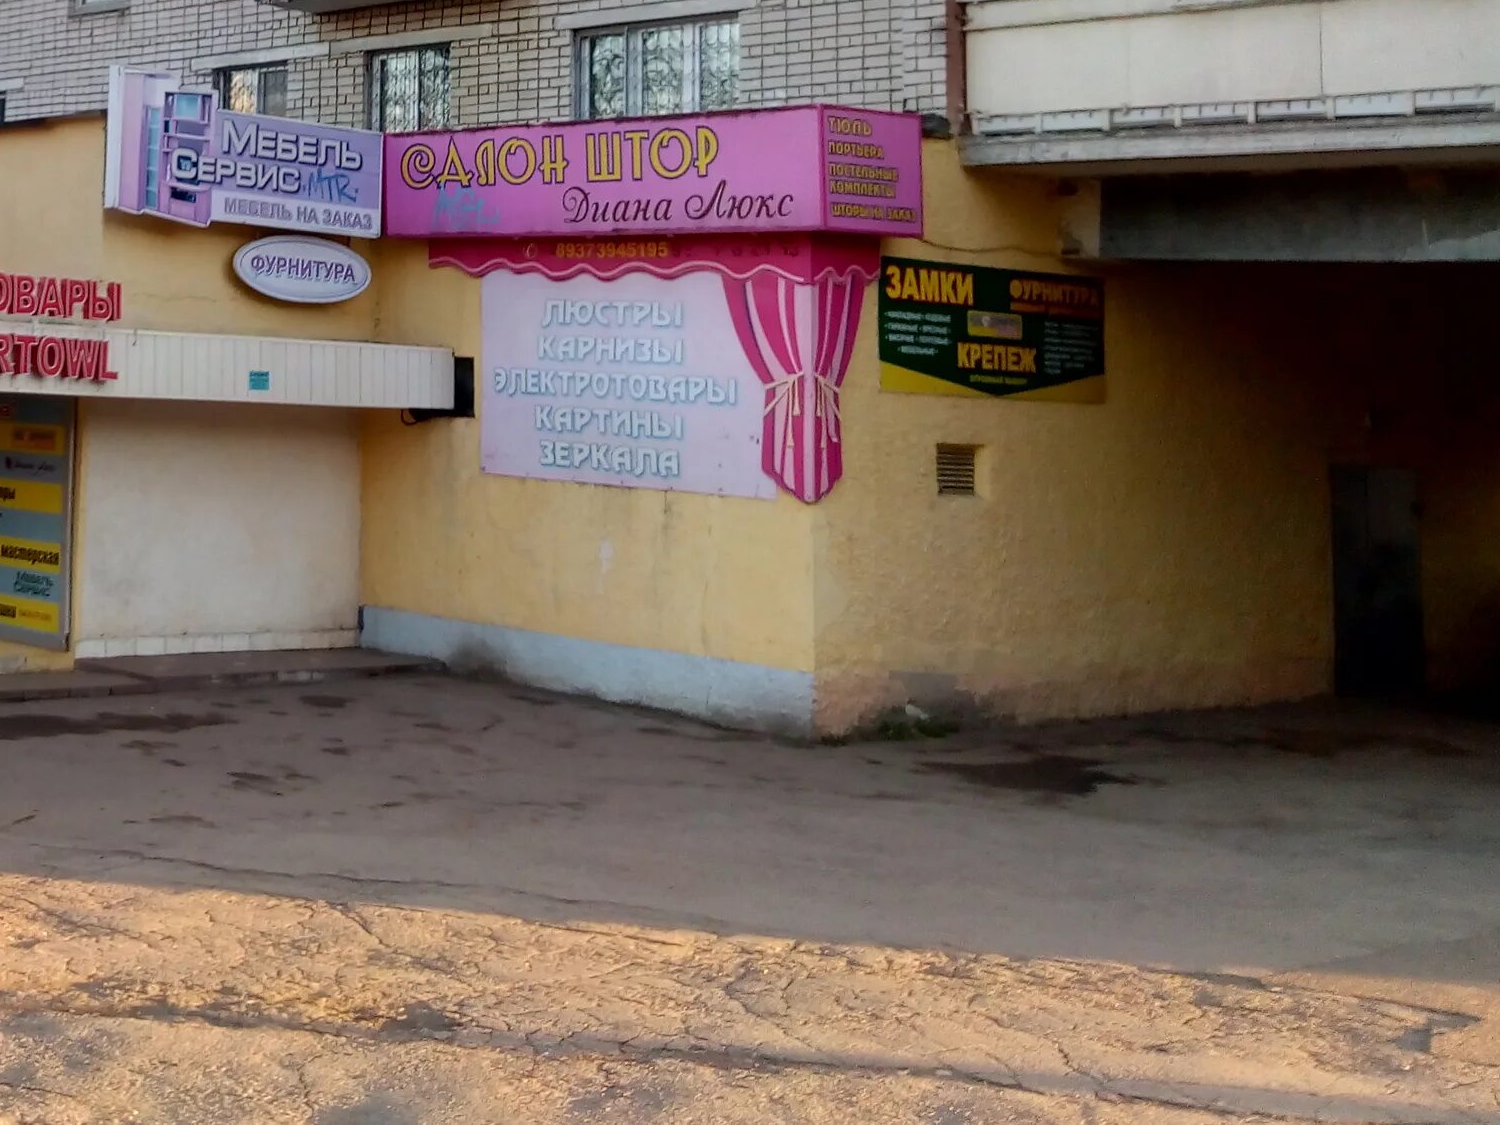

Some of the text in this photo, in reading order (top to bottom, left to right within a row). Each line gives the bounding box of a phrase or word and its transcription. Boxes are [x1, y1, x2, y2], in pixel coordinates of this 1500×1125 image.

[828, 116, 873, 137] ТЮЛЬ
[400, 125, 720, 190] САЛОН ШТОР
[828, 140, 885, 160] ПОРТЬЕРА
[223, 197, 373, 231] МЕБЕЛЬ НА ЗАКАЗ
[561, 179, 794, 224] Диана Люкс
[250, 253, 357, 284] ФУРНИТУРА
[885, 264, 974, 306] ЗАМКИ
[542, 299, 684, 327] ЛЮСТРЫ
[537, 336, 684, 364] КАРНИЗЫ
[957, 341, 1037, 374] КРЕПЕЖ
[493, 367, 737, 405] ЭЛЕКТРОТОВАРЫ
[534, 405, 684, 440] КАРТИНЫ
[539, 439, 681, 477] ЗЕРКАЛА
